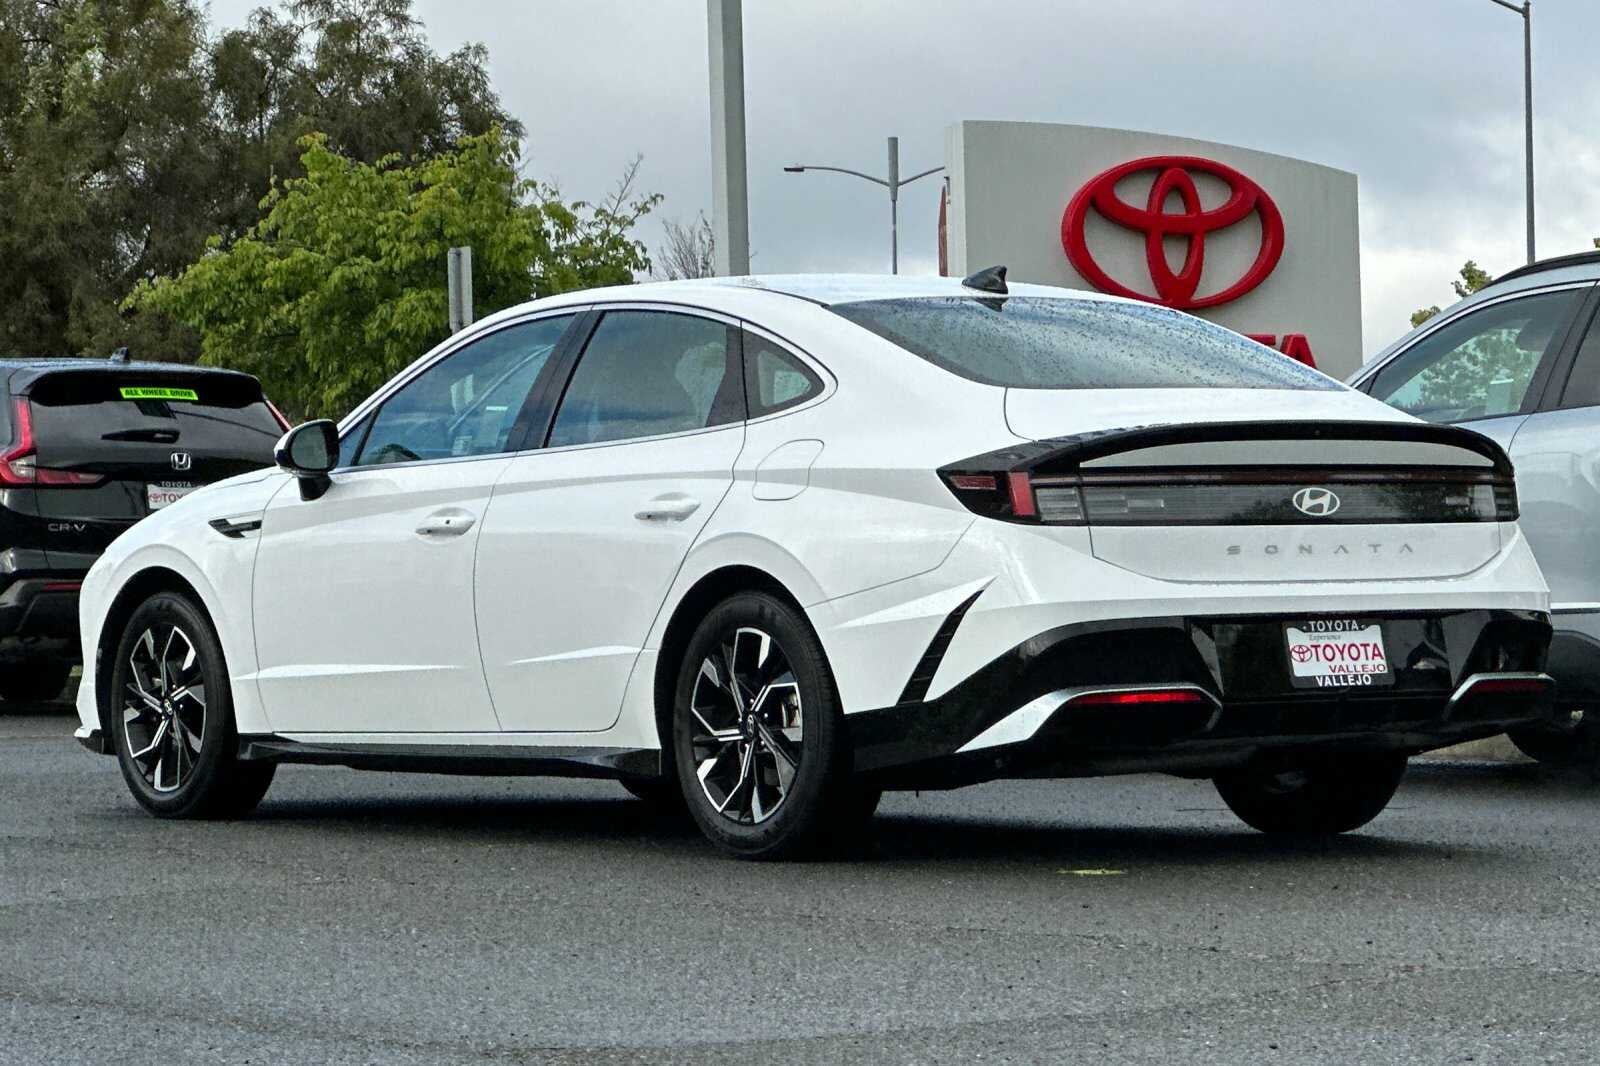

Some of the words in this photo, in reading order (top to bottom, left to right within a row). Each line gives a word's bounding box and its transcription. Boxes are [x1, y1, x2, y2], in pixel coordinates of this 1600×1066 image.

[141, 389, 168, 397] WHEEL
[169, 390, 194, 398] DRIVE
[47, 522, 86, 532] CR-V
[1226, 543, 1413, 556] SONATA
[1308, 620, 1359, 632] TOYOTA
[1310, 643, 1385, 662] TOYOTA
[1329, 663, 1386, 674] VALLEJO
[1316, 674, 1372, 687] VALLEJO
